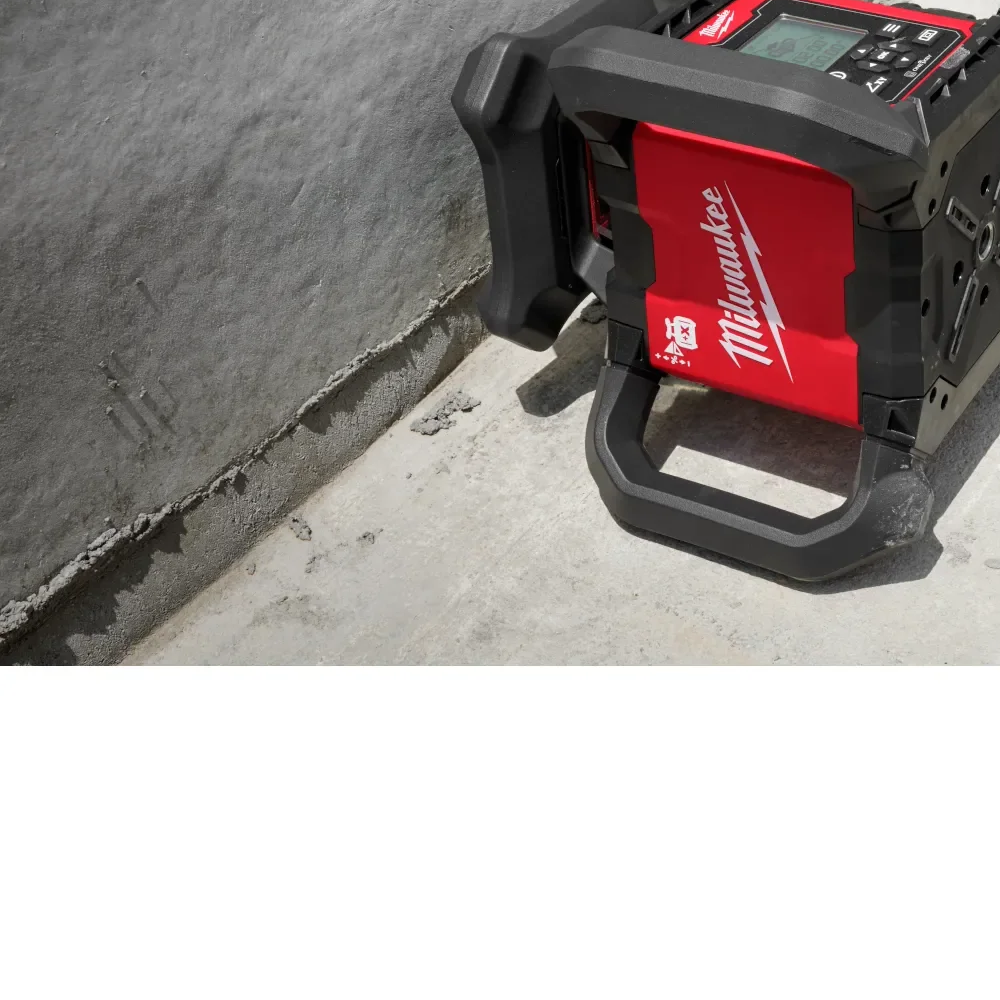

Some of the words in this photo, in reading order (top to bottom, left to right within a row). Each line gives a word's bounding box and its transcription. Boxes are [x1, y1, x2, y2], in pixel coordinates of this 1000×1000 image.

[699, 10, 731, 37] Milwaukee
[877, 51, 890, 59] OK
[700, 185, 773, 368] Milwaukee
